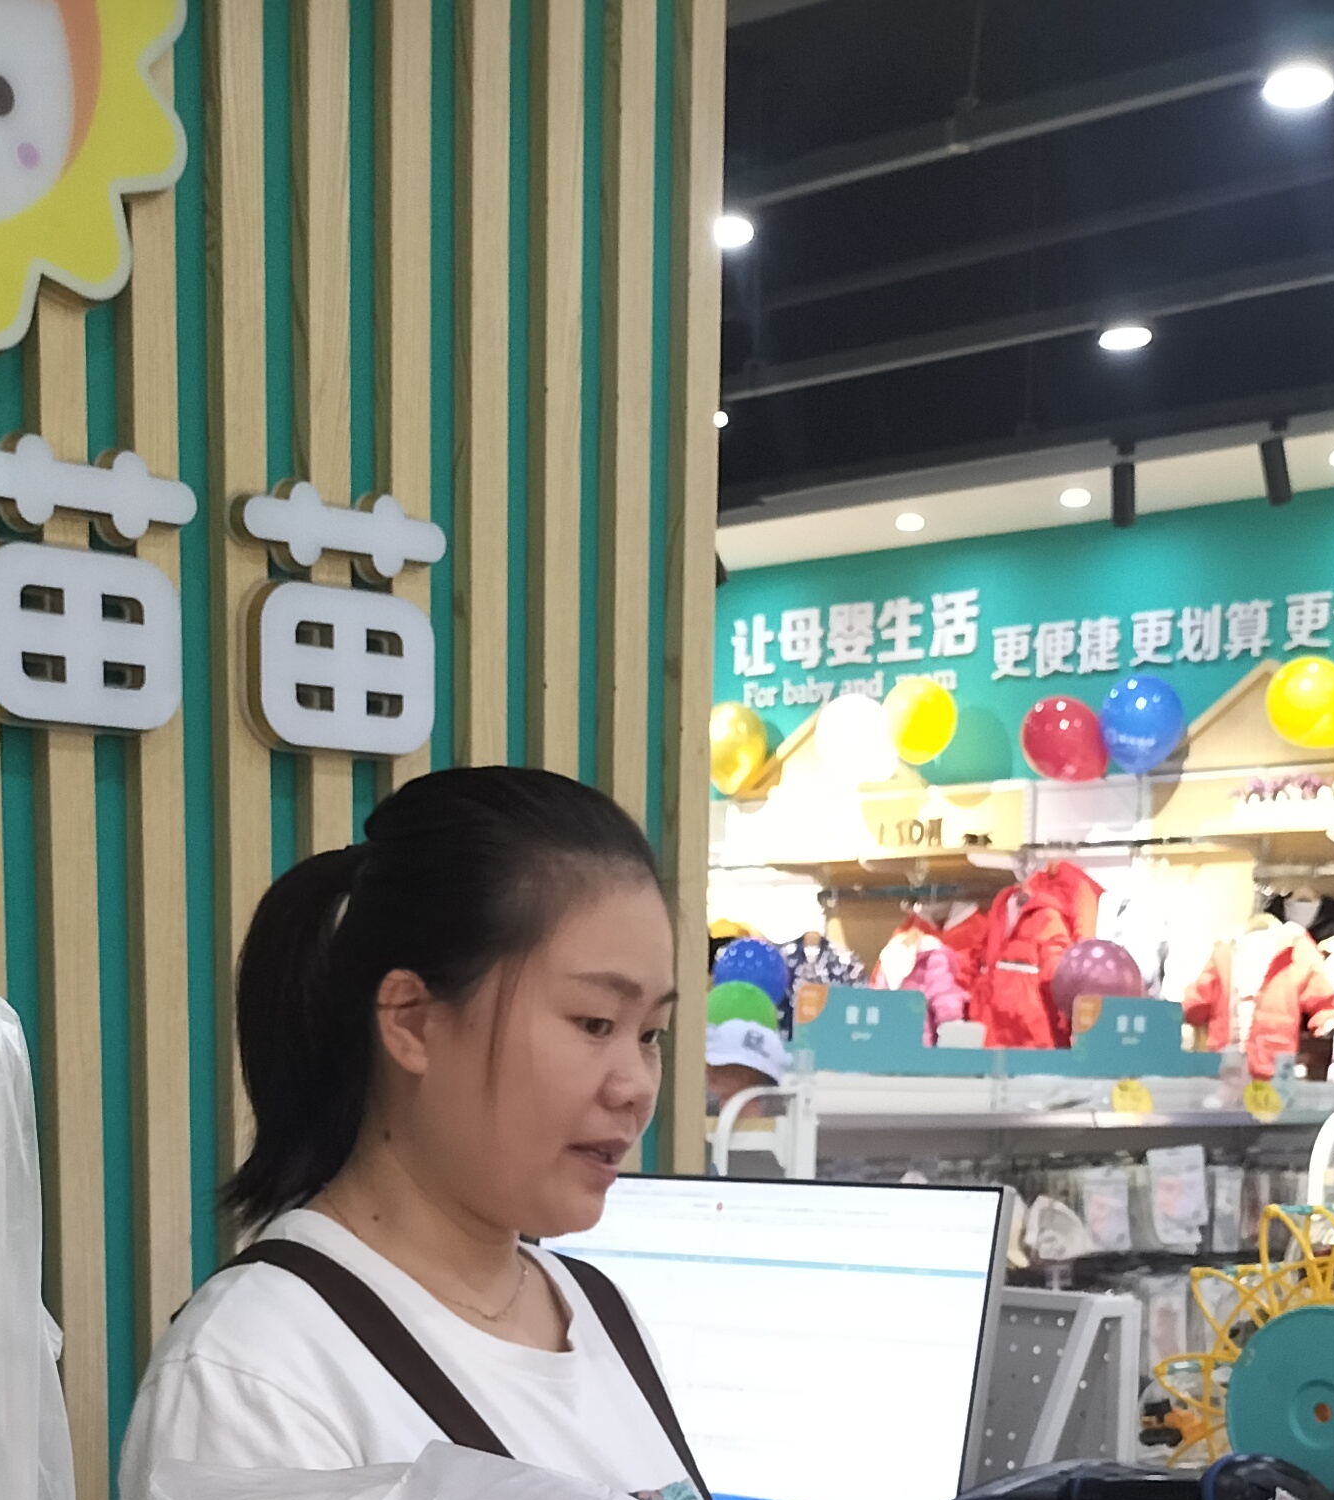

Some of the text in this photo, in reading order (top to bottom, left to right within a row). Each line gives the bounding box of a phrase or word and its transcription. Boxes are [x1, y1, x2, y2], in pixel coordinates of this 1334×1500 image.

[731, 588, 979, 677] 让母婴生活
[991, 615, 1121, 681] 更便捷
[1129, 598, 1274, 667] 更划算
[741, 681, 778, 709] For
[781, 677, 835, 707] baby
[837, 669, 885, 702] and
